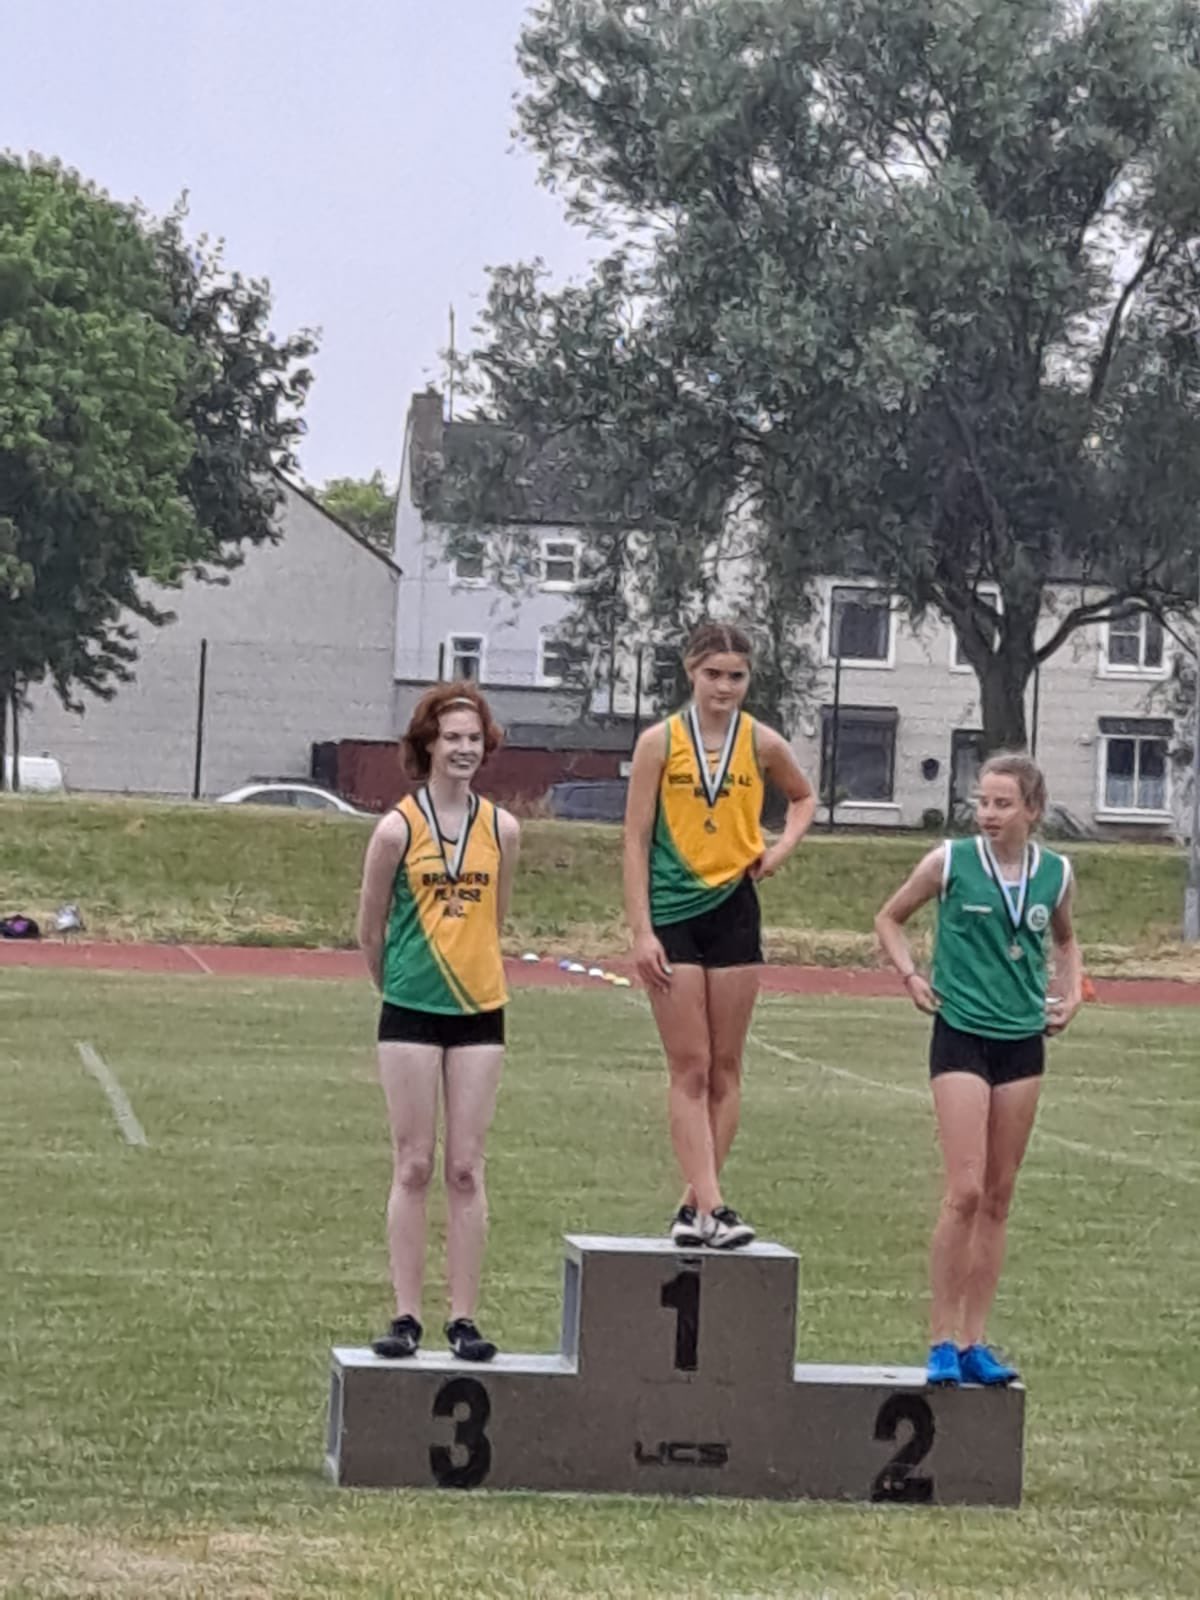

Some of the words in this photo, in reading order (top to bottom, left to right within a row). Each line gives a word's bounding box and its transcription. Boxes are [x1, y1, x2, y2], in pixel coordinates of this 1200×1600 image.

[661, 1269, 701, 1371] 1
[429, 1377, 491, 1488] 3
[634, 1440, 729, 1468] UCS
[873, 1392, 936, 1503] 2
